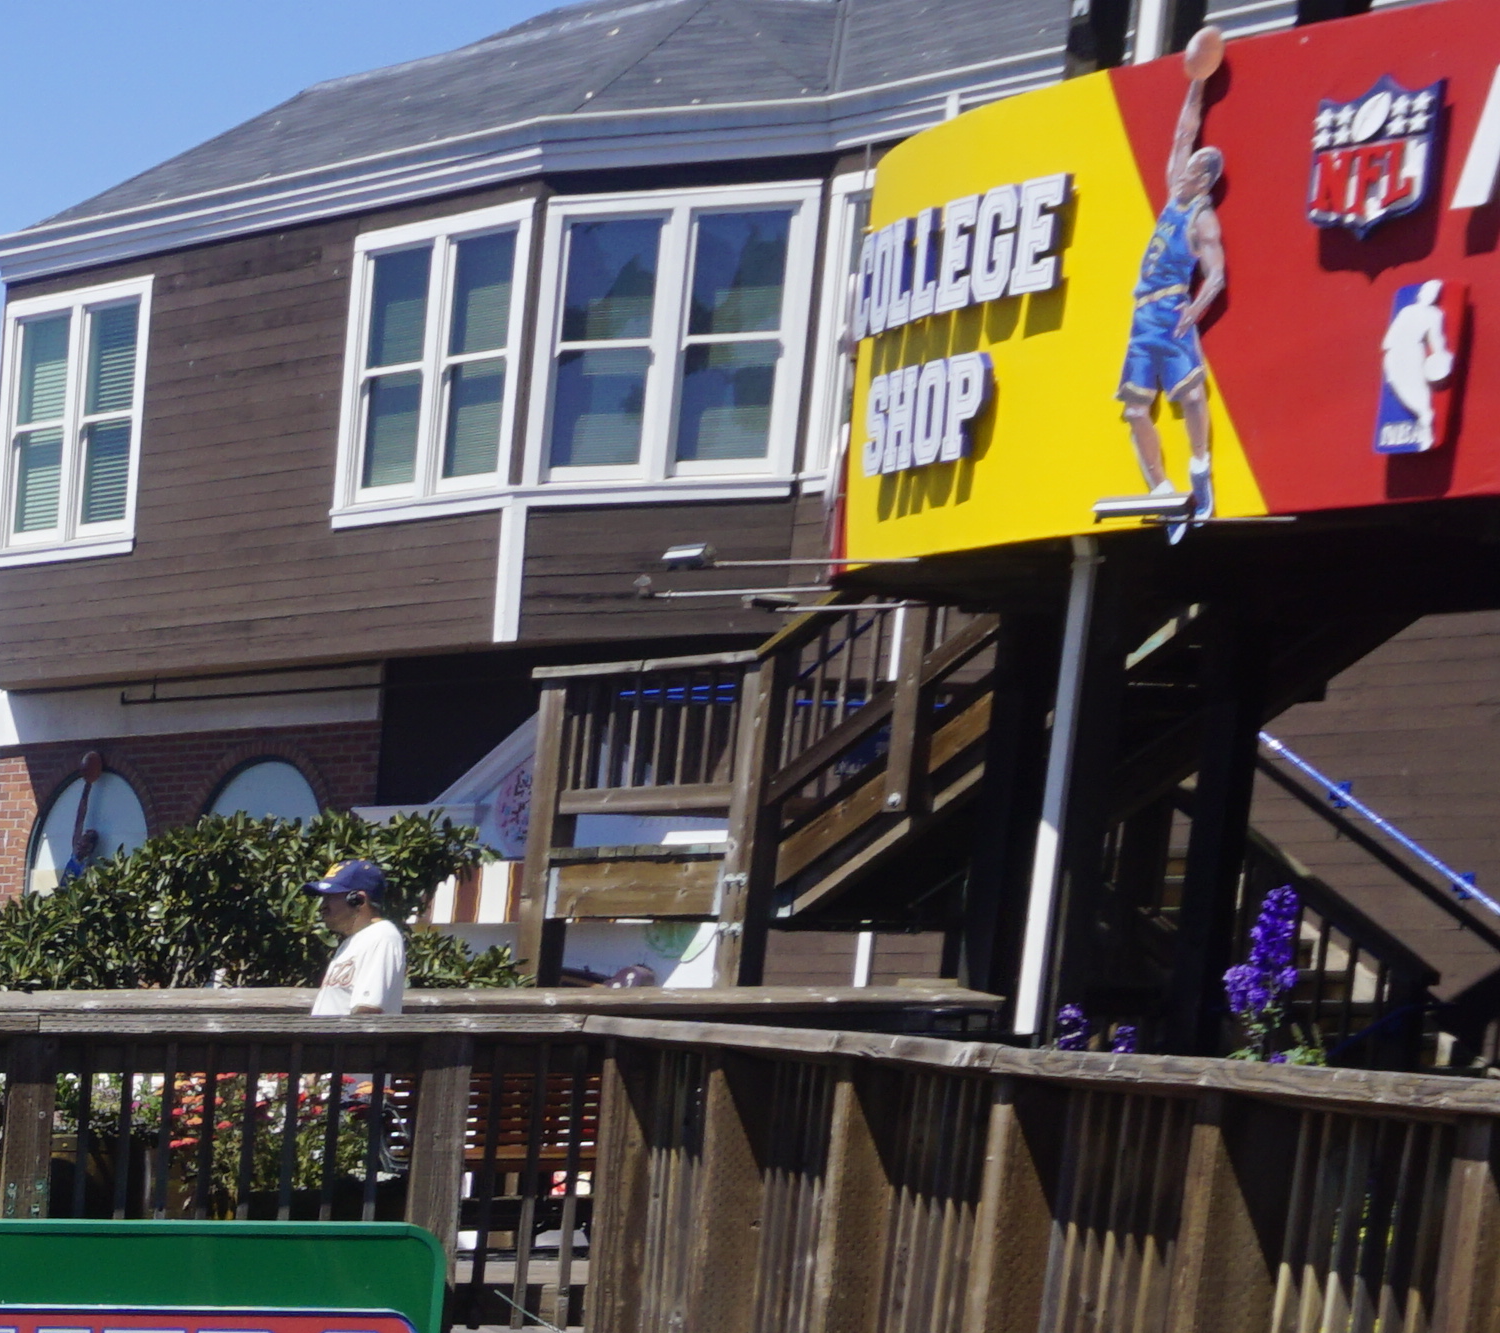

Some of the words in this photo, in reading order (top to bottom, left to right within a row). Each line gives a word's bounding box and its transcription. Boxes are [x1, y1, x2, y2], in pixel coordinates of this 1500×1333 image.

[1314, 139, 1415, 219] NFL
[855, 174, 1069, 340] COLLEGE
[863, 353, 991, 477] SHOP
